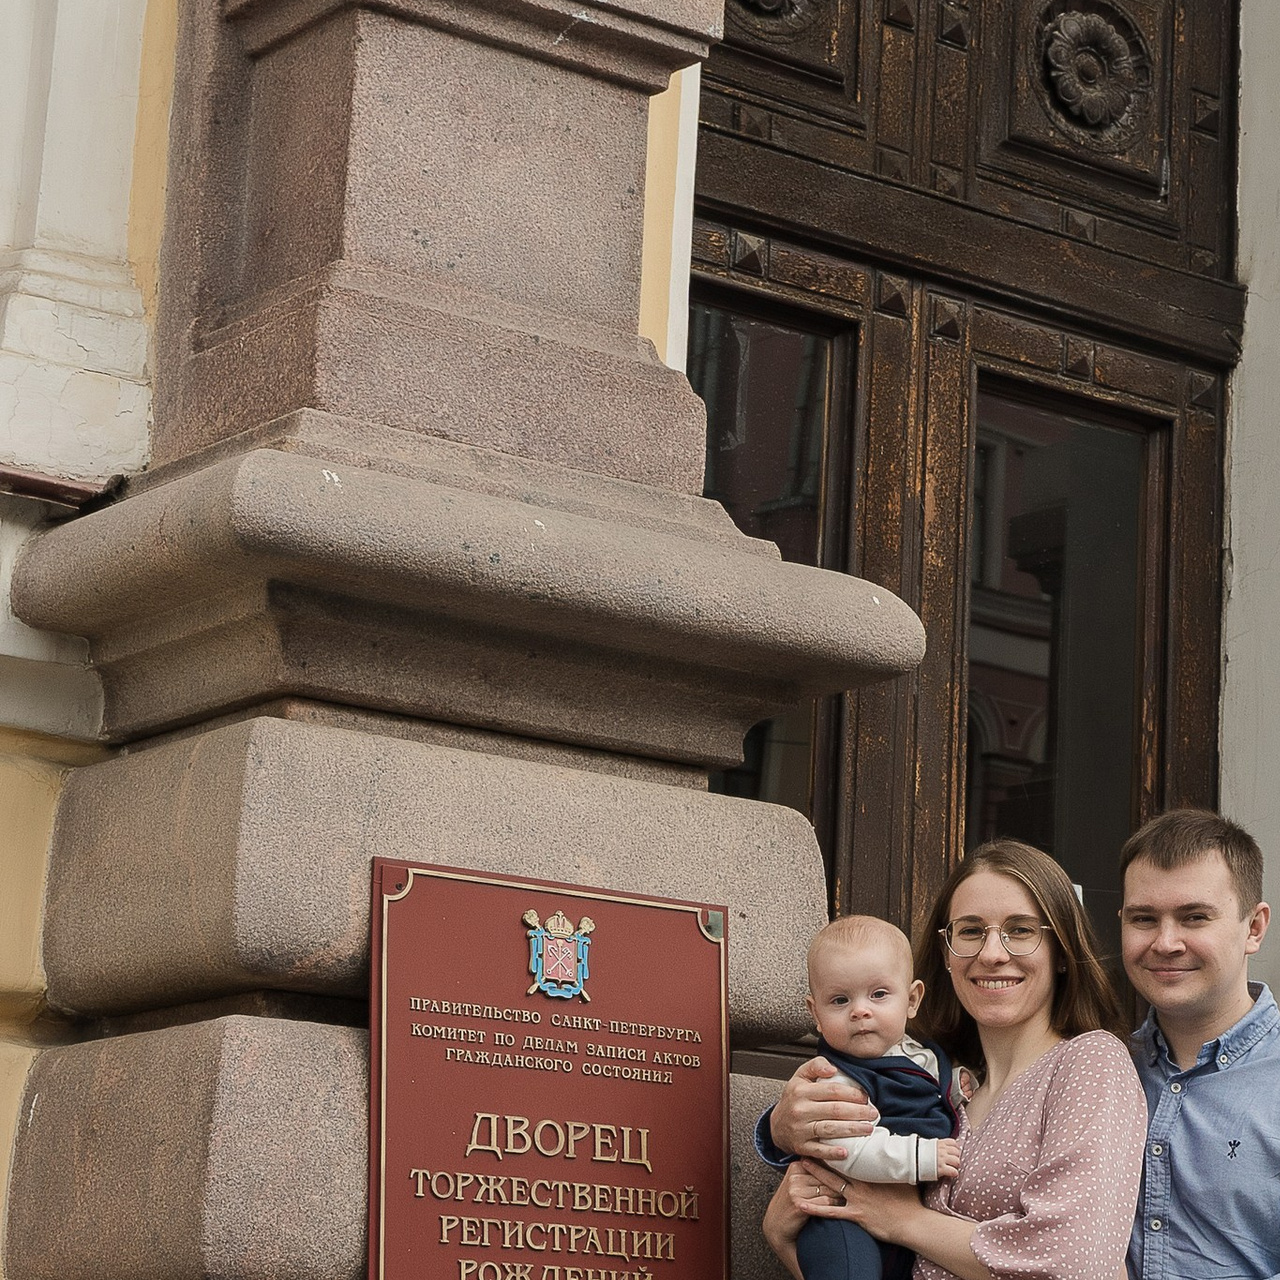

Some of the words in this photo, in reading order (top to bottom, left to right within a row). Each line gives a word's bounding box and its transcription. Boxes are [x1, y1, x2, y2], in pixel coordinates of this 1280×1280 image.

[409, 997, 541, 1024] ПРАВИТЕЛЬСТВО
[551, 1013, 702, 1043] САНКТ-ПЕТЕРБУРГА
[411, 1023, 486, 1044] КОМИТЕТ
[494, 1032, 515, 1047] ПО
[523, 1035, 579, 1054] ДЕЛАМ
[586, 1042, 646, 1062] ЗАПИСИ
[652, 1051, 701, 1068] АКТОВ
[446, 1047, 573, 1073] ГРАЖДАНСКОГО
[581, 1062, 673, 1084] СОСТОЯНИЯ
[465, 1112, 653, 1173] ДВОРЕЦ
[409, 1168, 700, 1220] ТОРЖЕСТВЕННОЙ
[438, 1215, 676, 1262] РЕГИСТРАЦИИ
